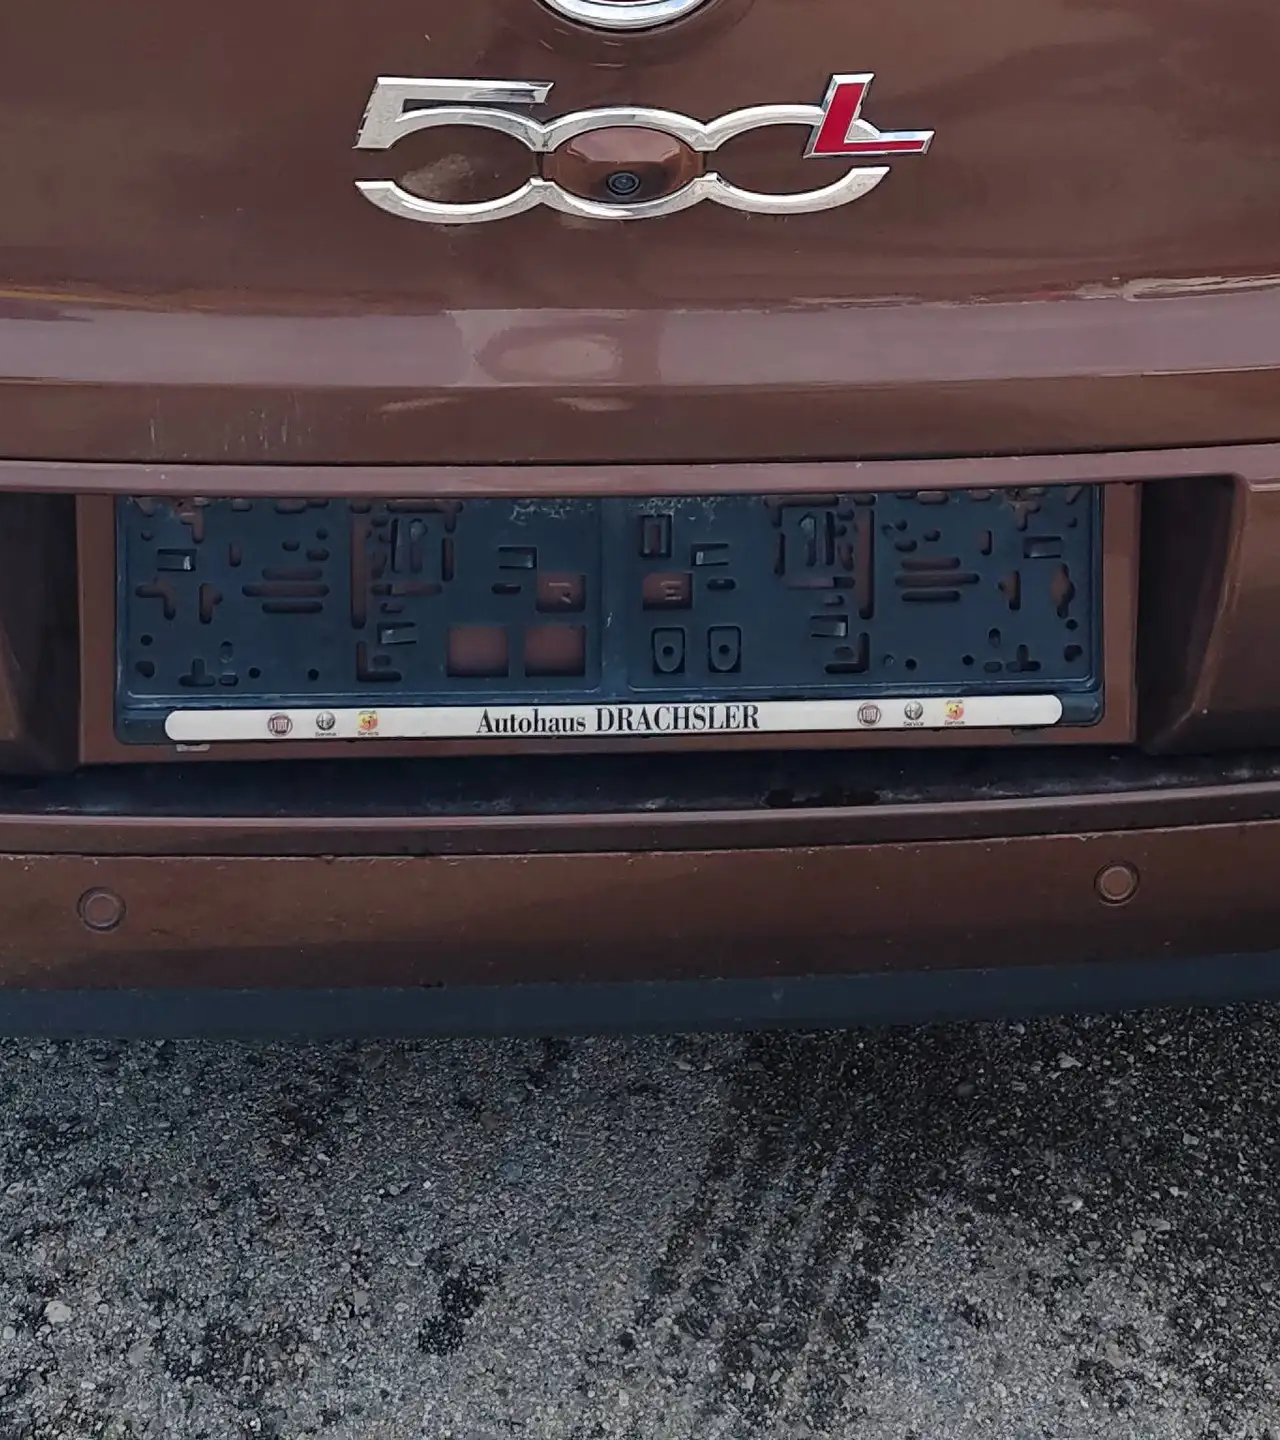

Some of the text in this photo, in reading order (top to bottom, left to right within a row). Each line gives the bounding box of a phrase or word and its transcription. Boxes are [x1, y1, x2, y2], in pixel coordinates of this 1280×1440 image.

[353, 72, 936, 224] 500L
[476, 704, 760, 733] Autohaus DRACHSLER
